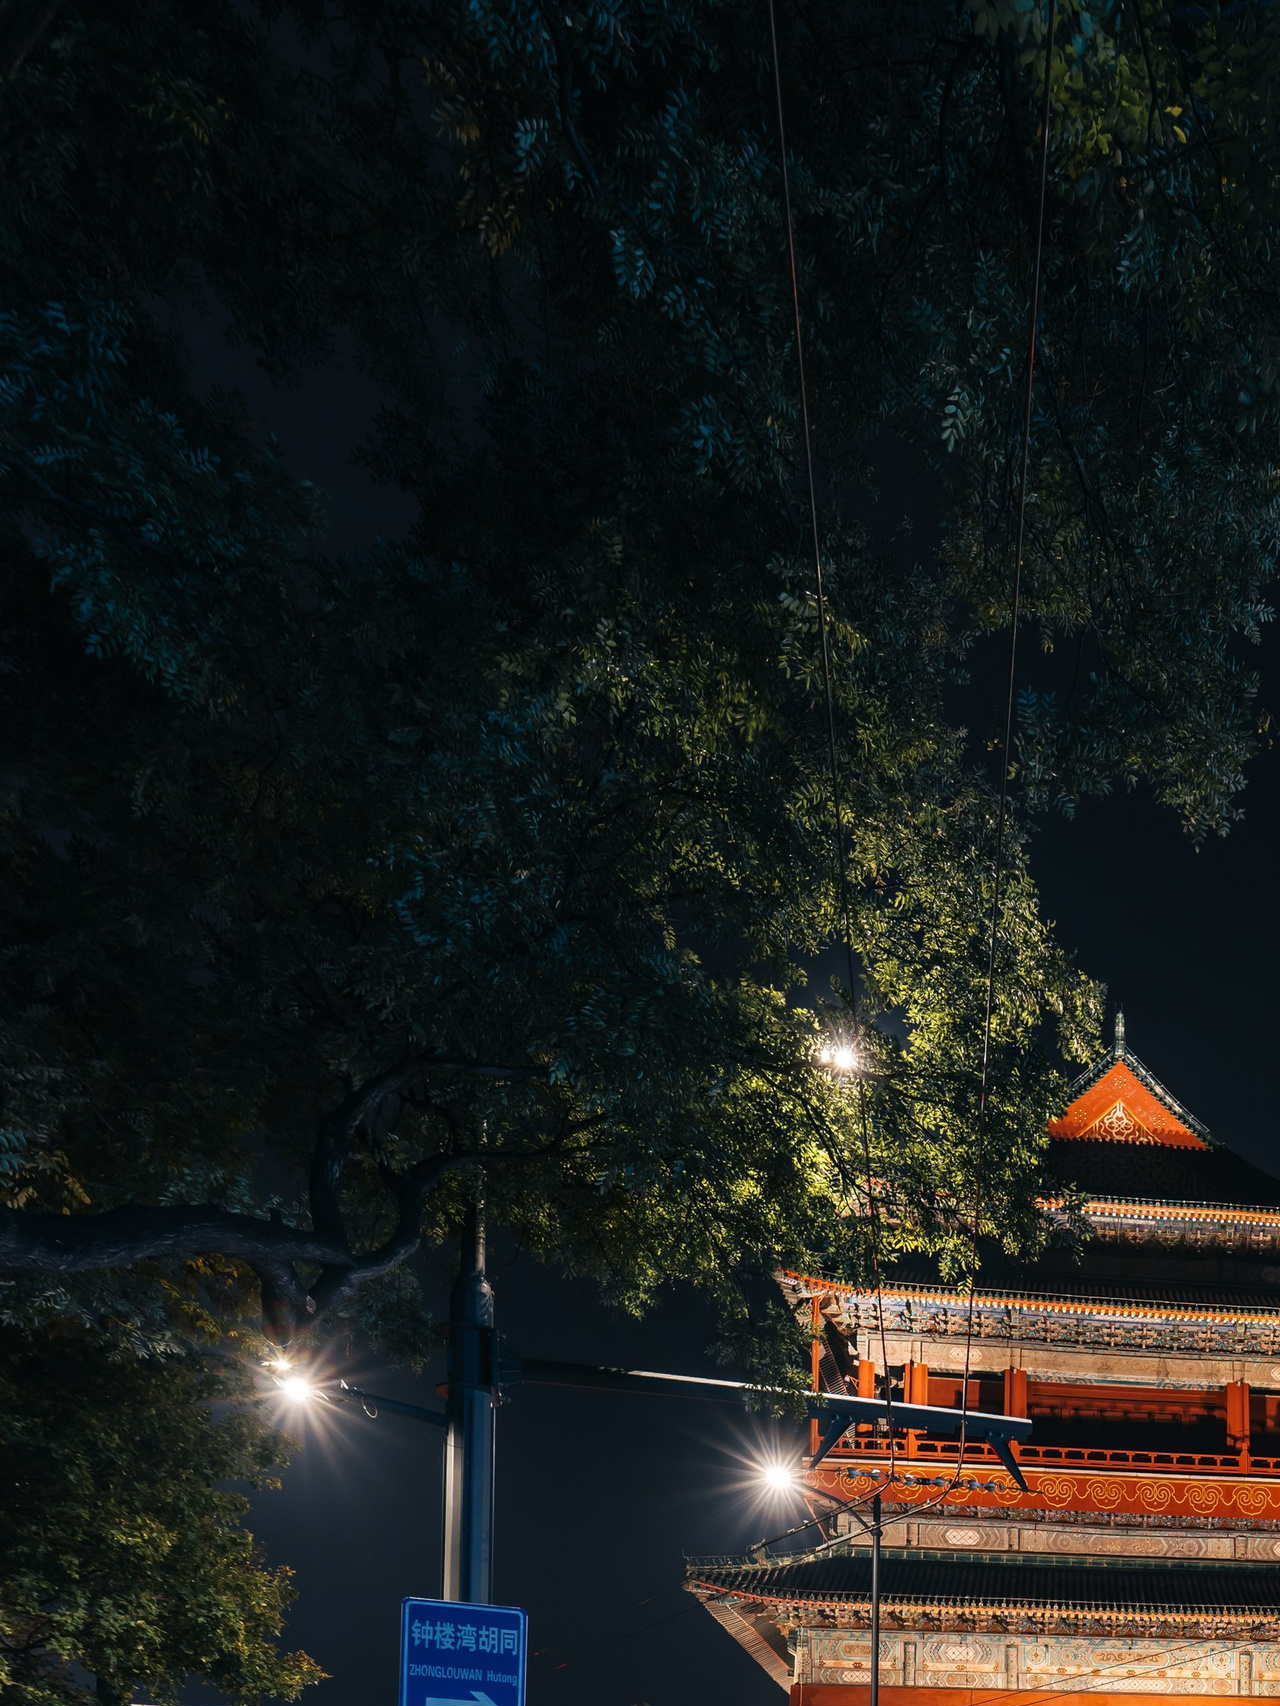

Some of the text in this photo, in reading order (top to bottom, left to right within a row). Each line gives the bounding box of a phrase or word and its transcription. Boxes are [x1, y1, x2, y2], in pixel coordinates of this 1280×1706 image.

[411, 1619, 518, 1656] 钟楼湾胡同
[409, 1664, 518, 1686] ZHONGLOUWAN Hutong
